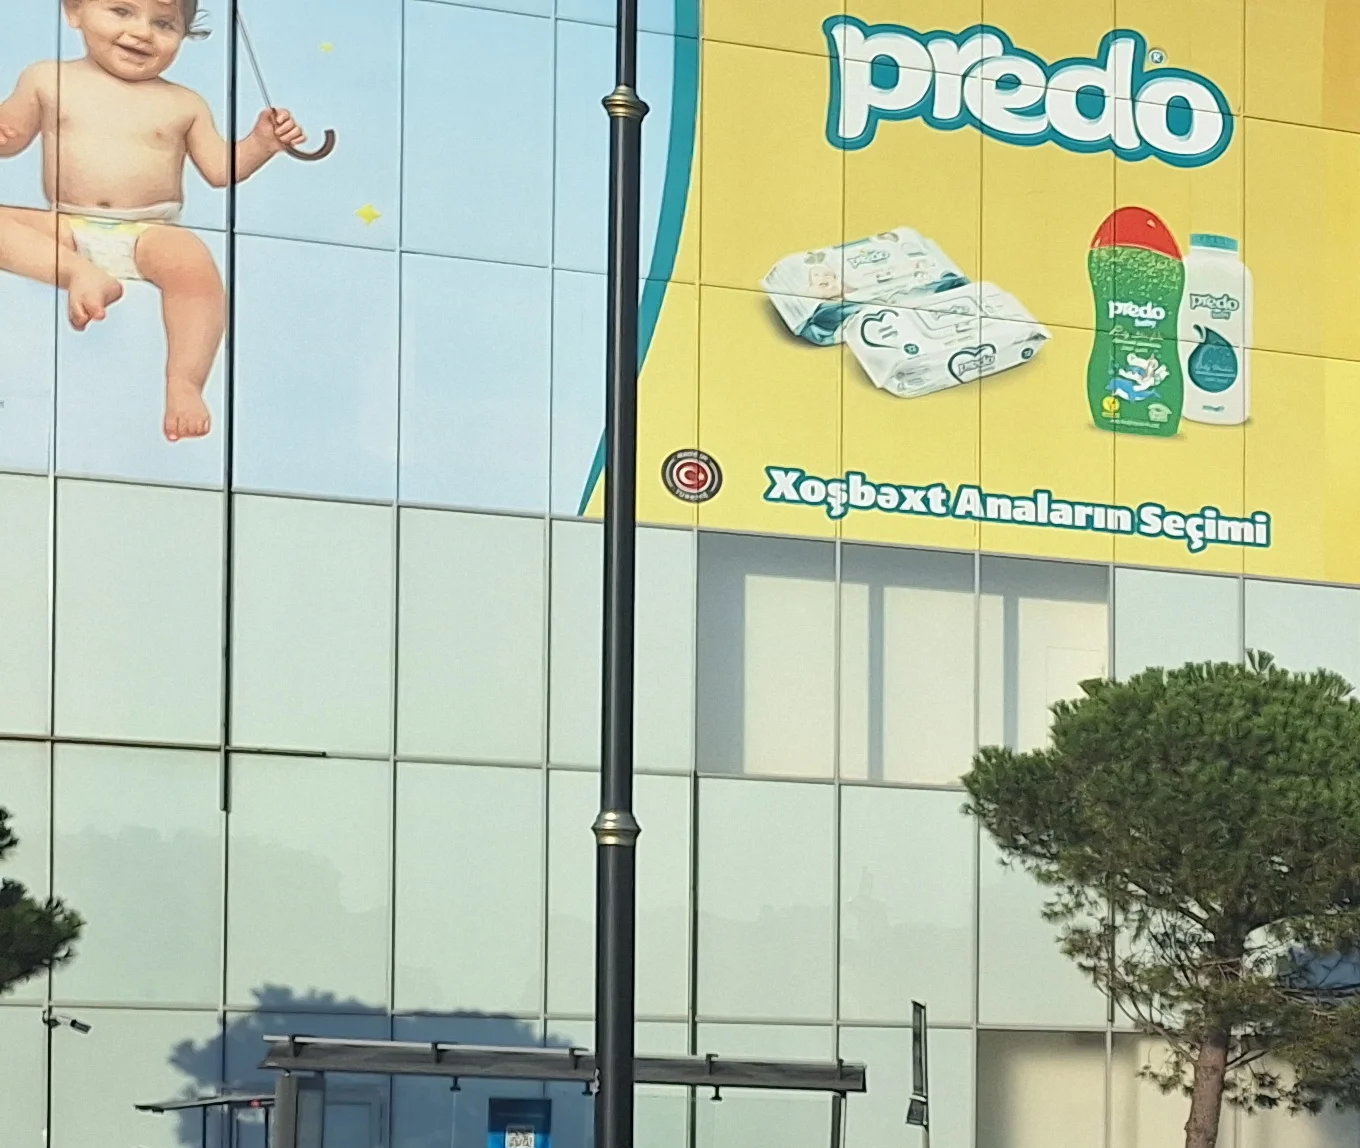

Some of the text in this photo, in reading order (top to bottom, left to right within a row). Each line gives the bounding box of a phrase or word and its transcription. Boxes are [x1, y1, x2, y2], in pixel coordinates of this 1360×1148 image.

[829, 20, 1226, 157] predo
[1108, 301, 1166, 320] predo
[768, 469, 1268, 551] Xoşbəxt Anaların Seçimi
